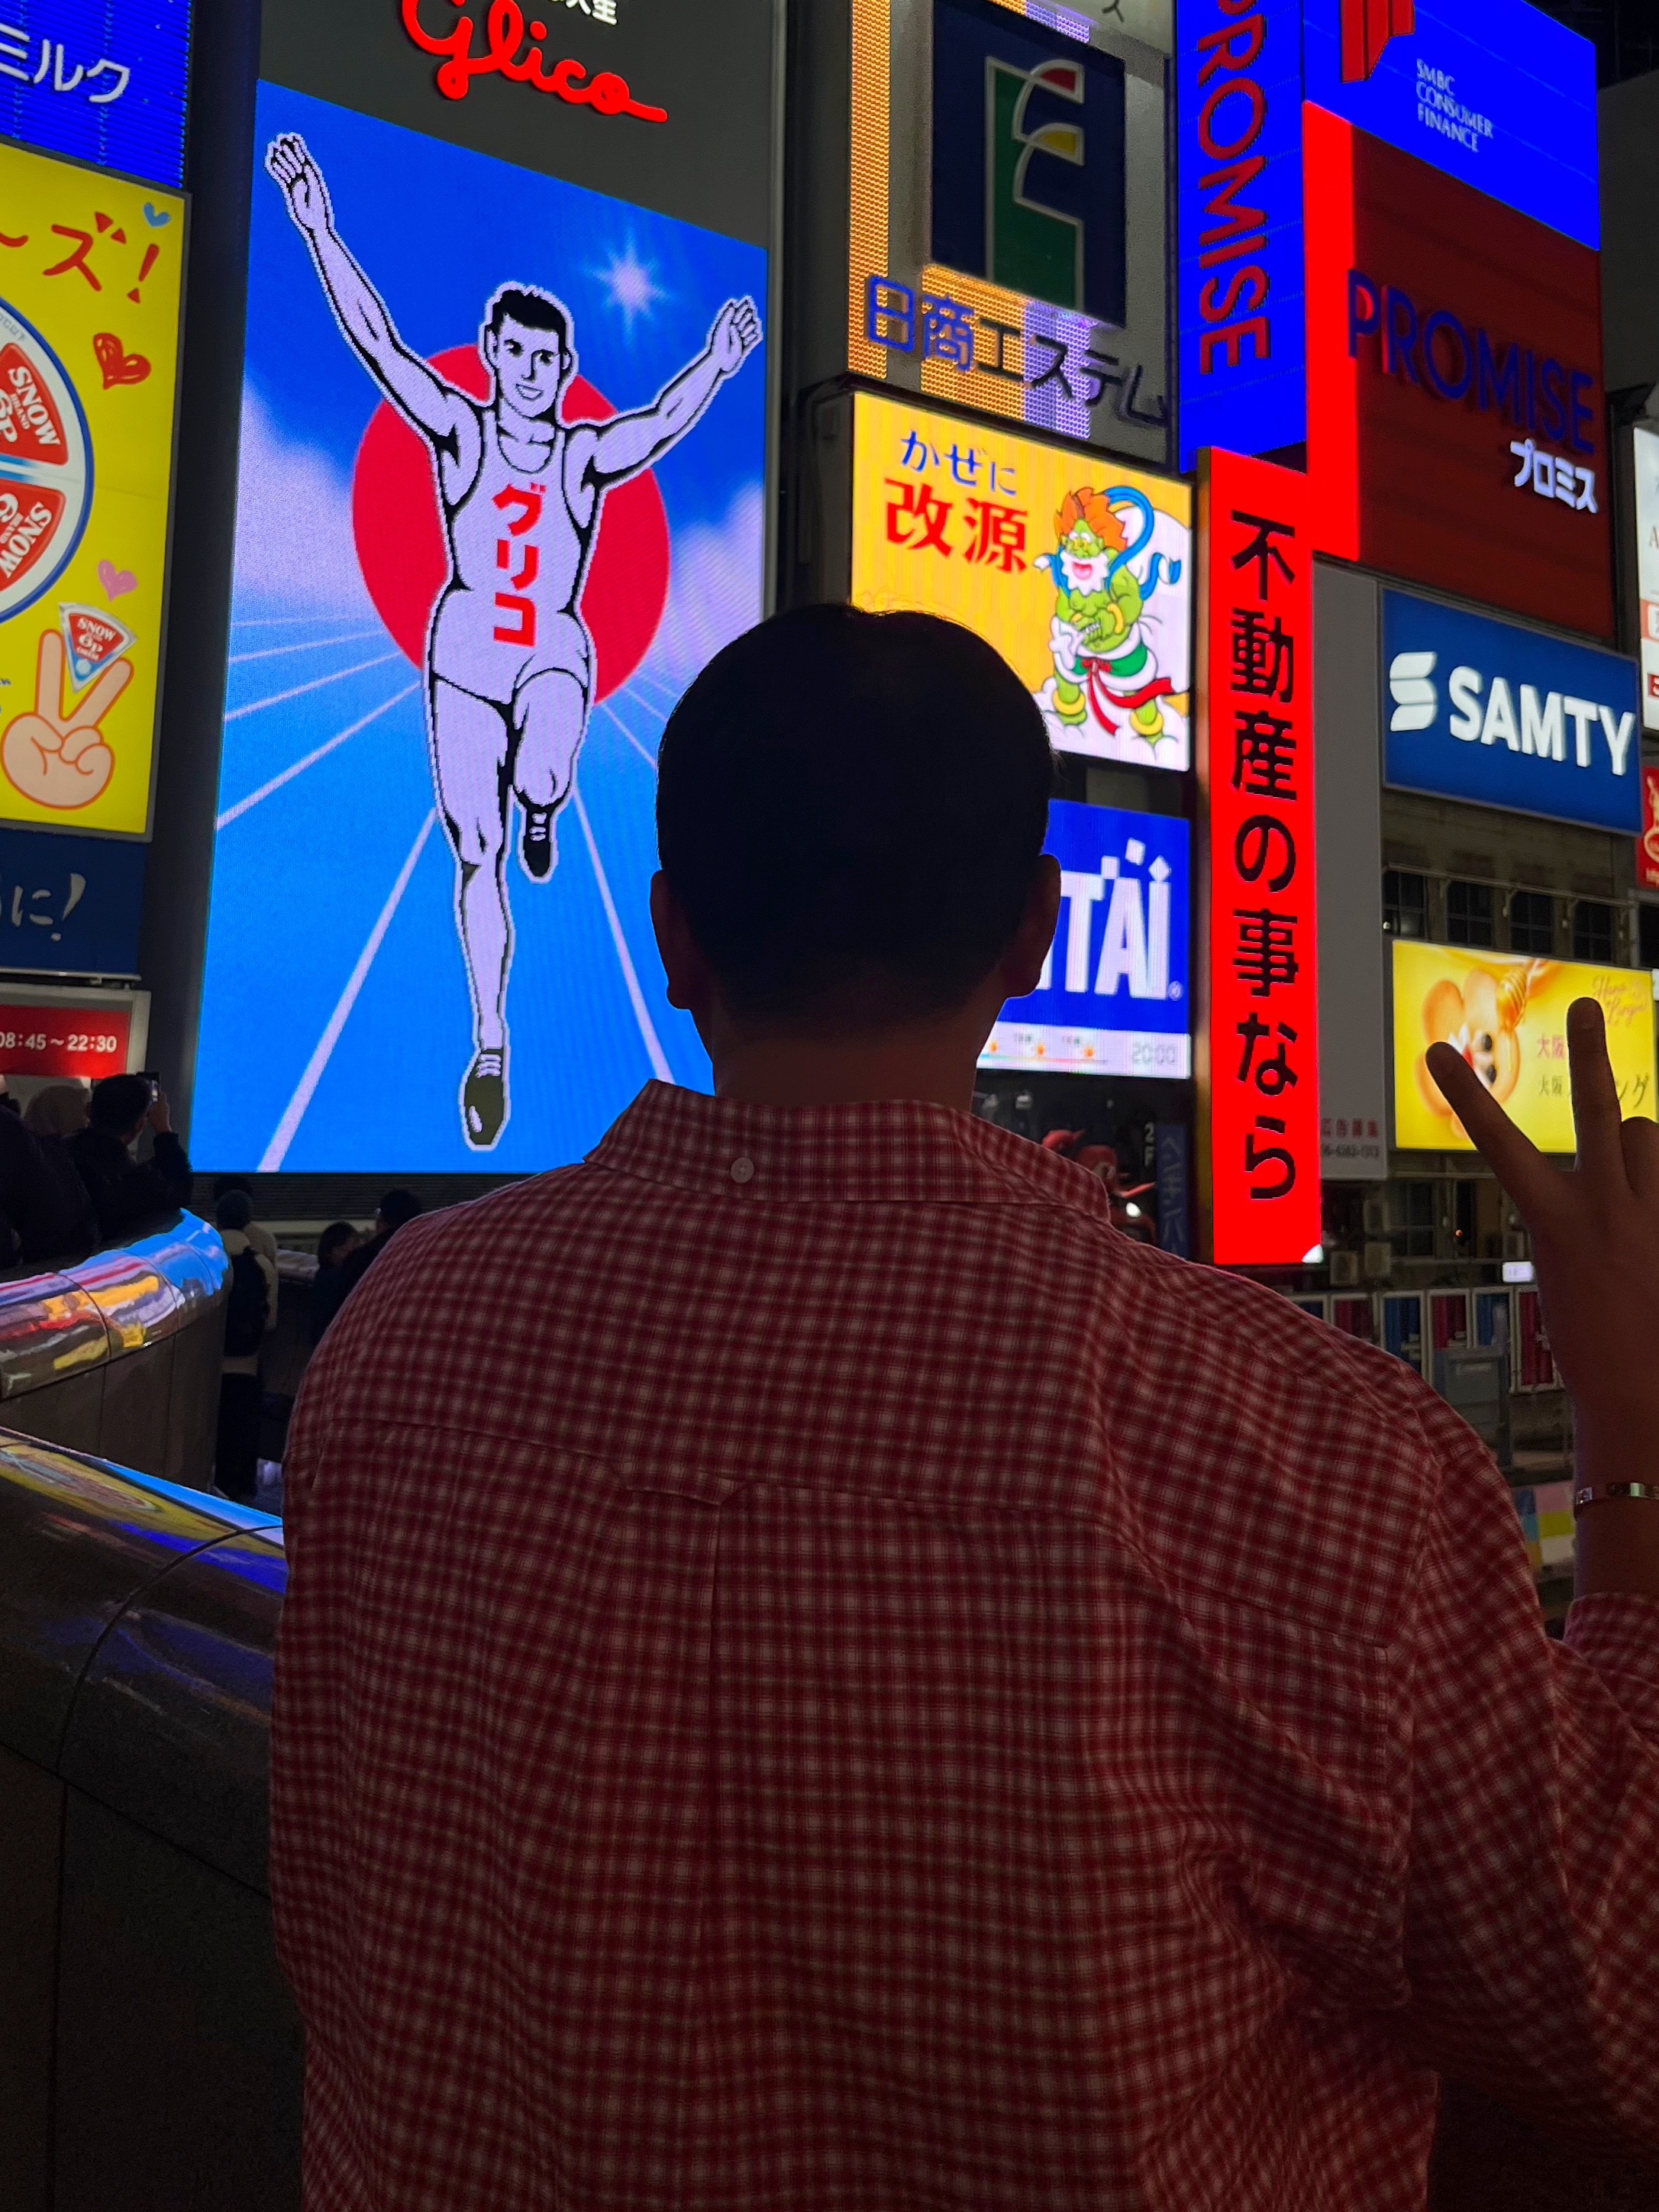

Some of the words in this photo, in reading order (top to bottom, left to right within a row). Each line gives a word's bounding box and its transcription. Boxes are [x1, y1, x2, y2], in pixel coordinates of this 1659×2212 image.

[402, 0, 668, 123] Glico
[1417, 58, 1455, 97] SMBC
[1416, 80, 1494, 138] CONSUMER
[1418, 102, 1479, 153] FINANCE
[1347, 269, 1596, 455] PROMISE
[8, 366, 61, 445] SNOW
[901, 430, 1018, 496] かぜに
[1511, 438, 1597, 514] プロミス
[0, 501, 53, 579] SNOW
[491, 482, 547, 649] グリコ
[884, 479, 1029, 575] 改源
[77, 616, 117, 641] SNOW
[1449, 665, 1635, 776] SAMTY
[1231, 510, 1299, 1200] 不動産の事なら
